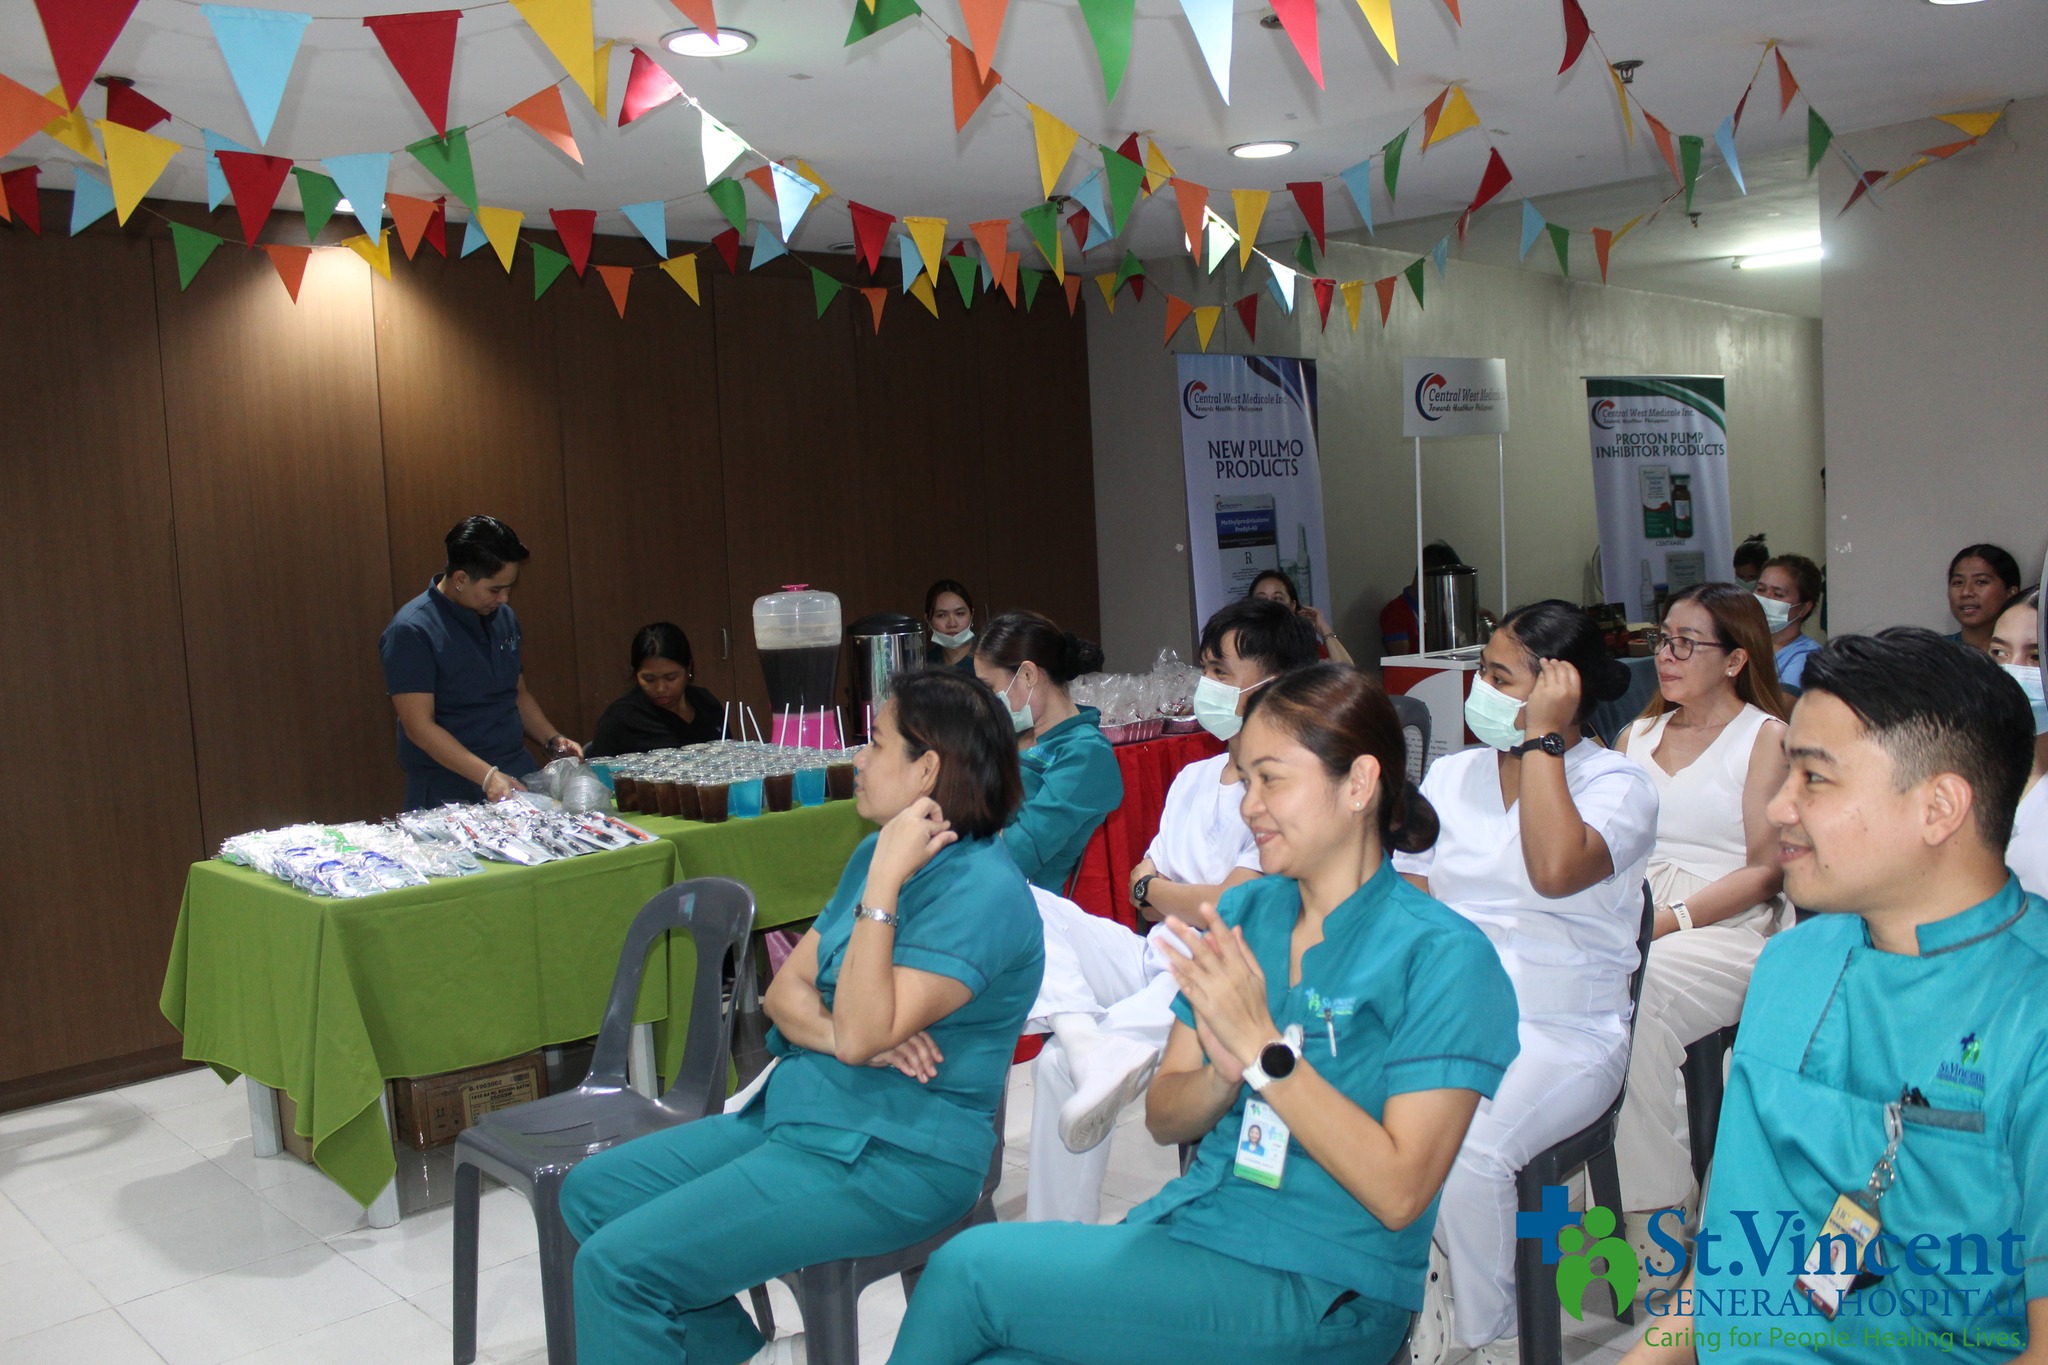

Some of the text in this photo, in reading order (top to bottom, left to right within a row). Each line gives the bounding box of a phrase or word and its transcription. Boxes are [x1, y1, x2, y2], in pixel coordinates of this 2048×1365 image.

[1194, 393, 1221, 404] Central
[1223, 393, 1241, 404] West
[1429, 388, 1460, 401] Central
[1462, 388, 1479, 401] West
[1602, 408, 1629, 418] Central
[1630, 408, 1647, 417] West
[1616, 432, 1704, 445] PROTON PUMP
[1208, 439, 1303, 459] NEW PULMO
[1596, 444, 1725, 458] INHIBITOR PRODUCTS
[1216, 459, 1298, 479] PRODUCTS
